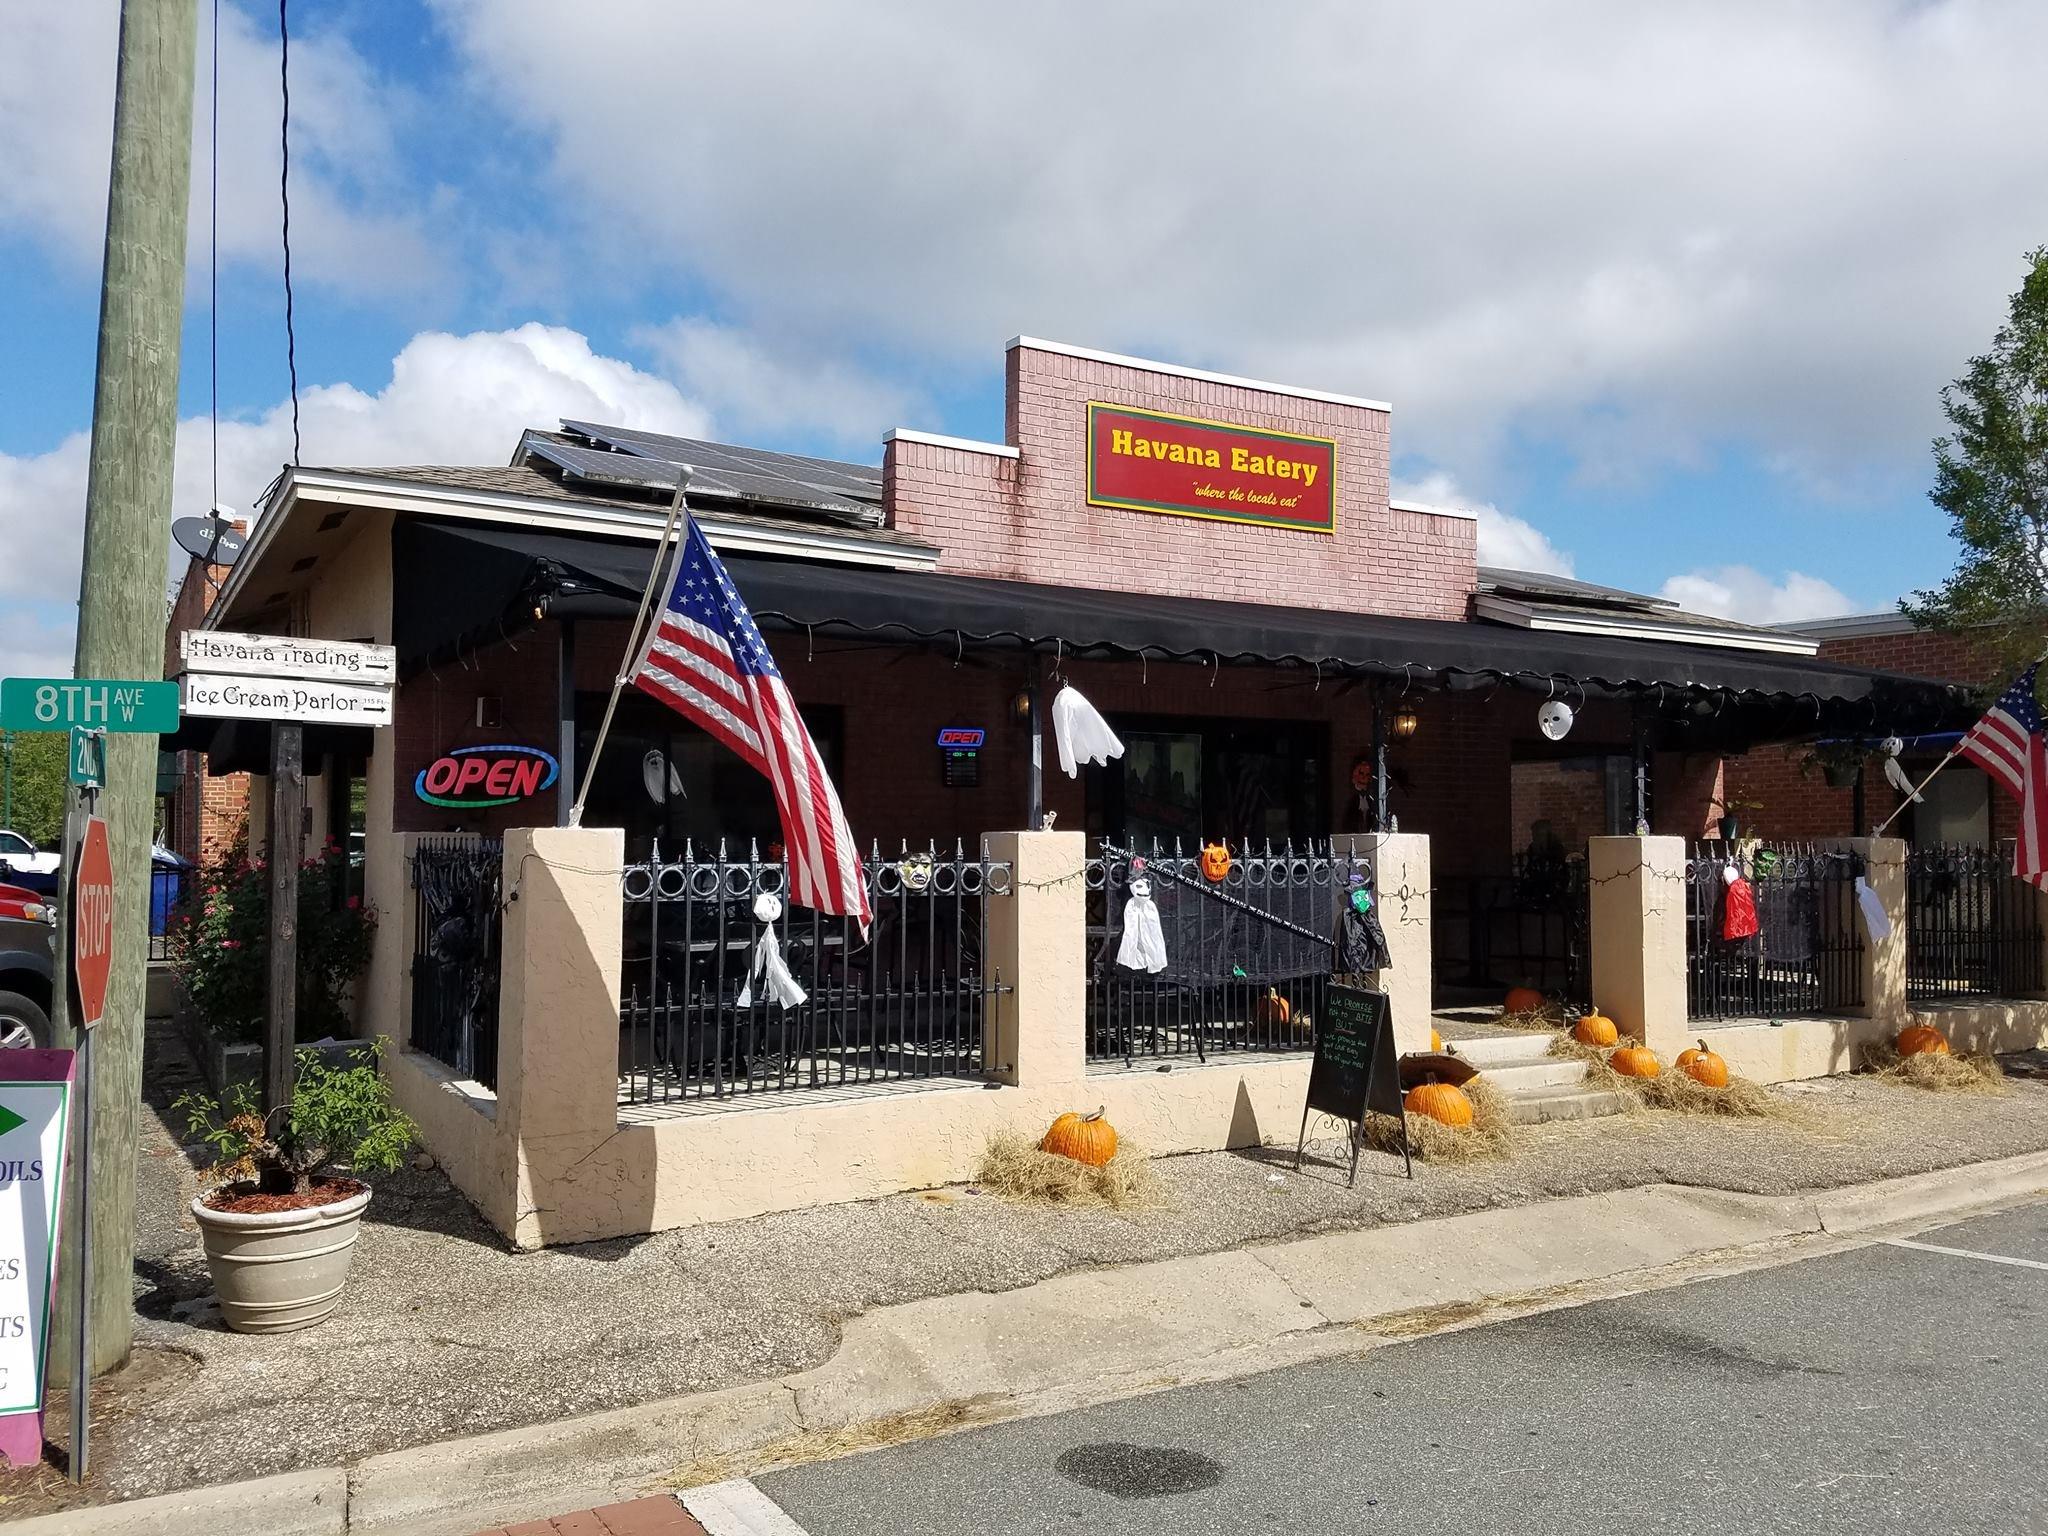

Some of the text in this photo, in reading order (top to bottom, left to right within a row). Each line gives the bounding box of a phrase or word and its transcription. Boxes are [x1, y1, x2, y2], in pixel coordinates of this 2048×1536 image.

[1111, 429, 1318, 487] Havana Eatery
[1228, 488, 1245, 502] the
[1247, 491, 1278, 506] locals
[199, 527, 227, 545] dih
[281, 643, 360, 672] Trading
[34, 685, 145, 722] 8TH AVE
[190, 684, 358, 712] Ice Cream Parlor
[121, 705, 135, 722] W
[942, 732, 981, 744] OPEN
[425, 756, 545, 797] OPEN
[1399, 862, 1409, 923] 102
[79, 883, 111, 960] STOP
[1330, 994, 1343, 1007] We
